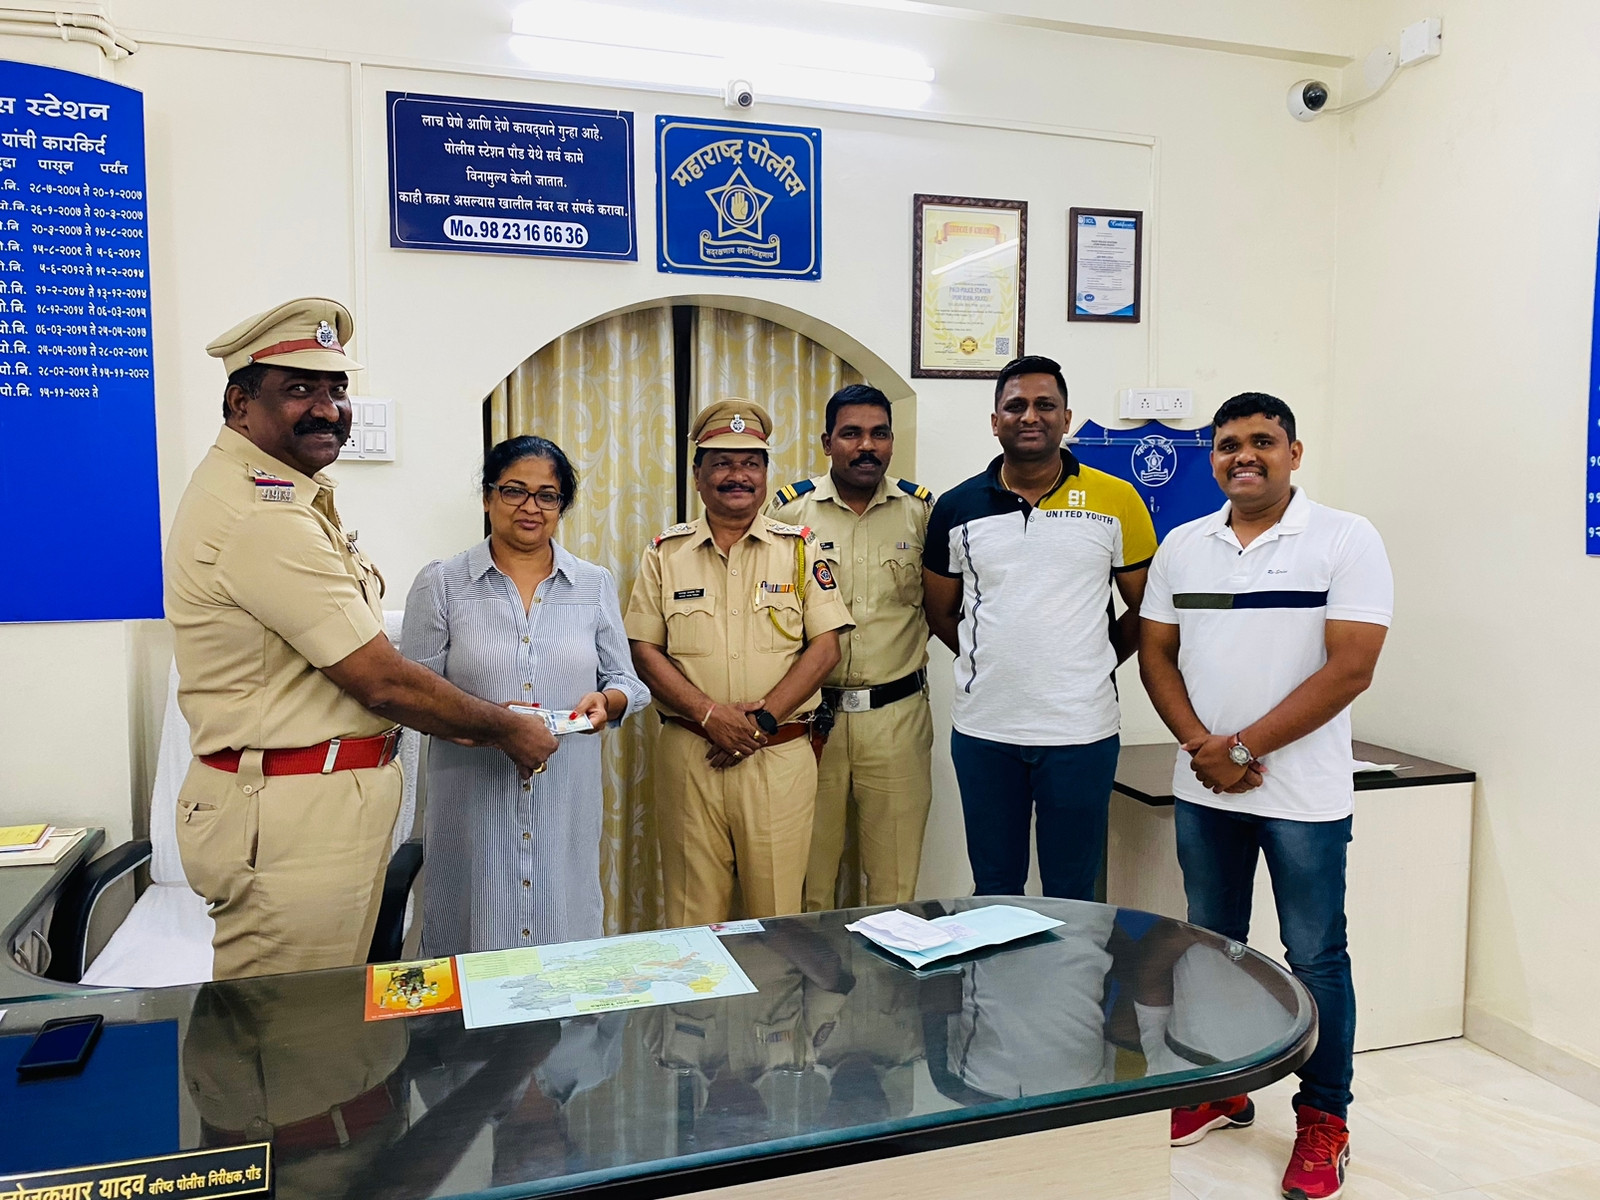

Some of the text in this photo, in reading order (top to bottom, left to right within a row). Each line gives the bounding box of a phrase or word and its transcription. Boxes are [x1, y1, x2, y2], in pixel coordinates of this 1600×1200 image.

[26, 93, 110, 120] स्टेशन
[421, 115, 443, 127] लाच
[446, 112, 463, 128] घेणे
[467, 115, 491, 130] आणि
[494, 116, 509, 133] देणे
[558, 126, 578, 142] गुन्हा
[582, 124, 602, 141] आहे.
[2, 128, 37, 148] यांची
[444, 138, 583, 163] पोलीस स्टेशन पौड येथे सर्व कामे
[38, 160, 73, 174] पासून
[100, 161, 128, 174] पर्यंत
[671, 137, 806, 197] महाराष्ट्र पोलीस
[466, 166, 566, 188] विनामुल्य केली जातात.
[83, 183, 89, 196] ते
[398, 189, 629, 216] काही तक्रार असल्यास खालील नंबर वर संपर्क करावा.
[84, 204, 90, 216] ते
[85, 223, 91, 235] ते
[85, 243, 92, 256] ते
[86, 263, 92, 275] ते
[88, 285, 94, 297] ते
[88, 302, 95, 315] ते
[90, 322, 96, 335] ते
[90, 342, 96, 356] ते
[92, 364, 97, 377] ते
[0, 383, 32, 396] पो.नि.
[92, 385, 98, 397] ते
[1068, 489, 1086, 507] 81
[1046, 510, 1114, 525] UNITED YOUTH
[99, 1174, 147, 1200] यादव
[148, 1176, 175, 1197] वरिष्ठ
[176, 1171, 206, 1192] पोलीस
